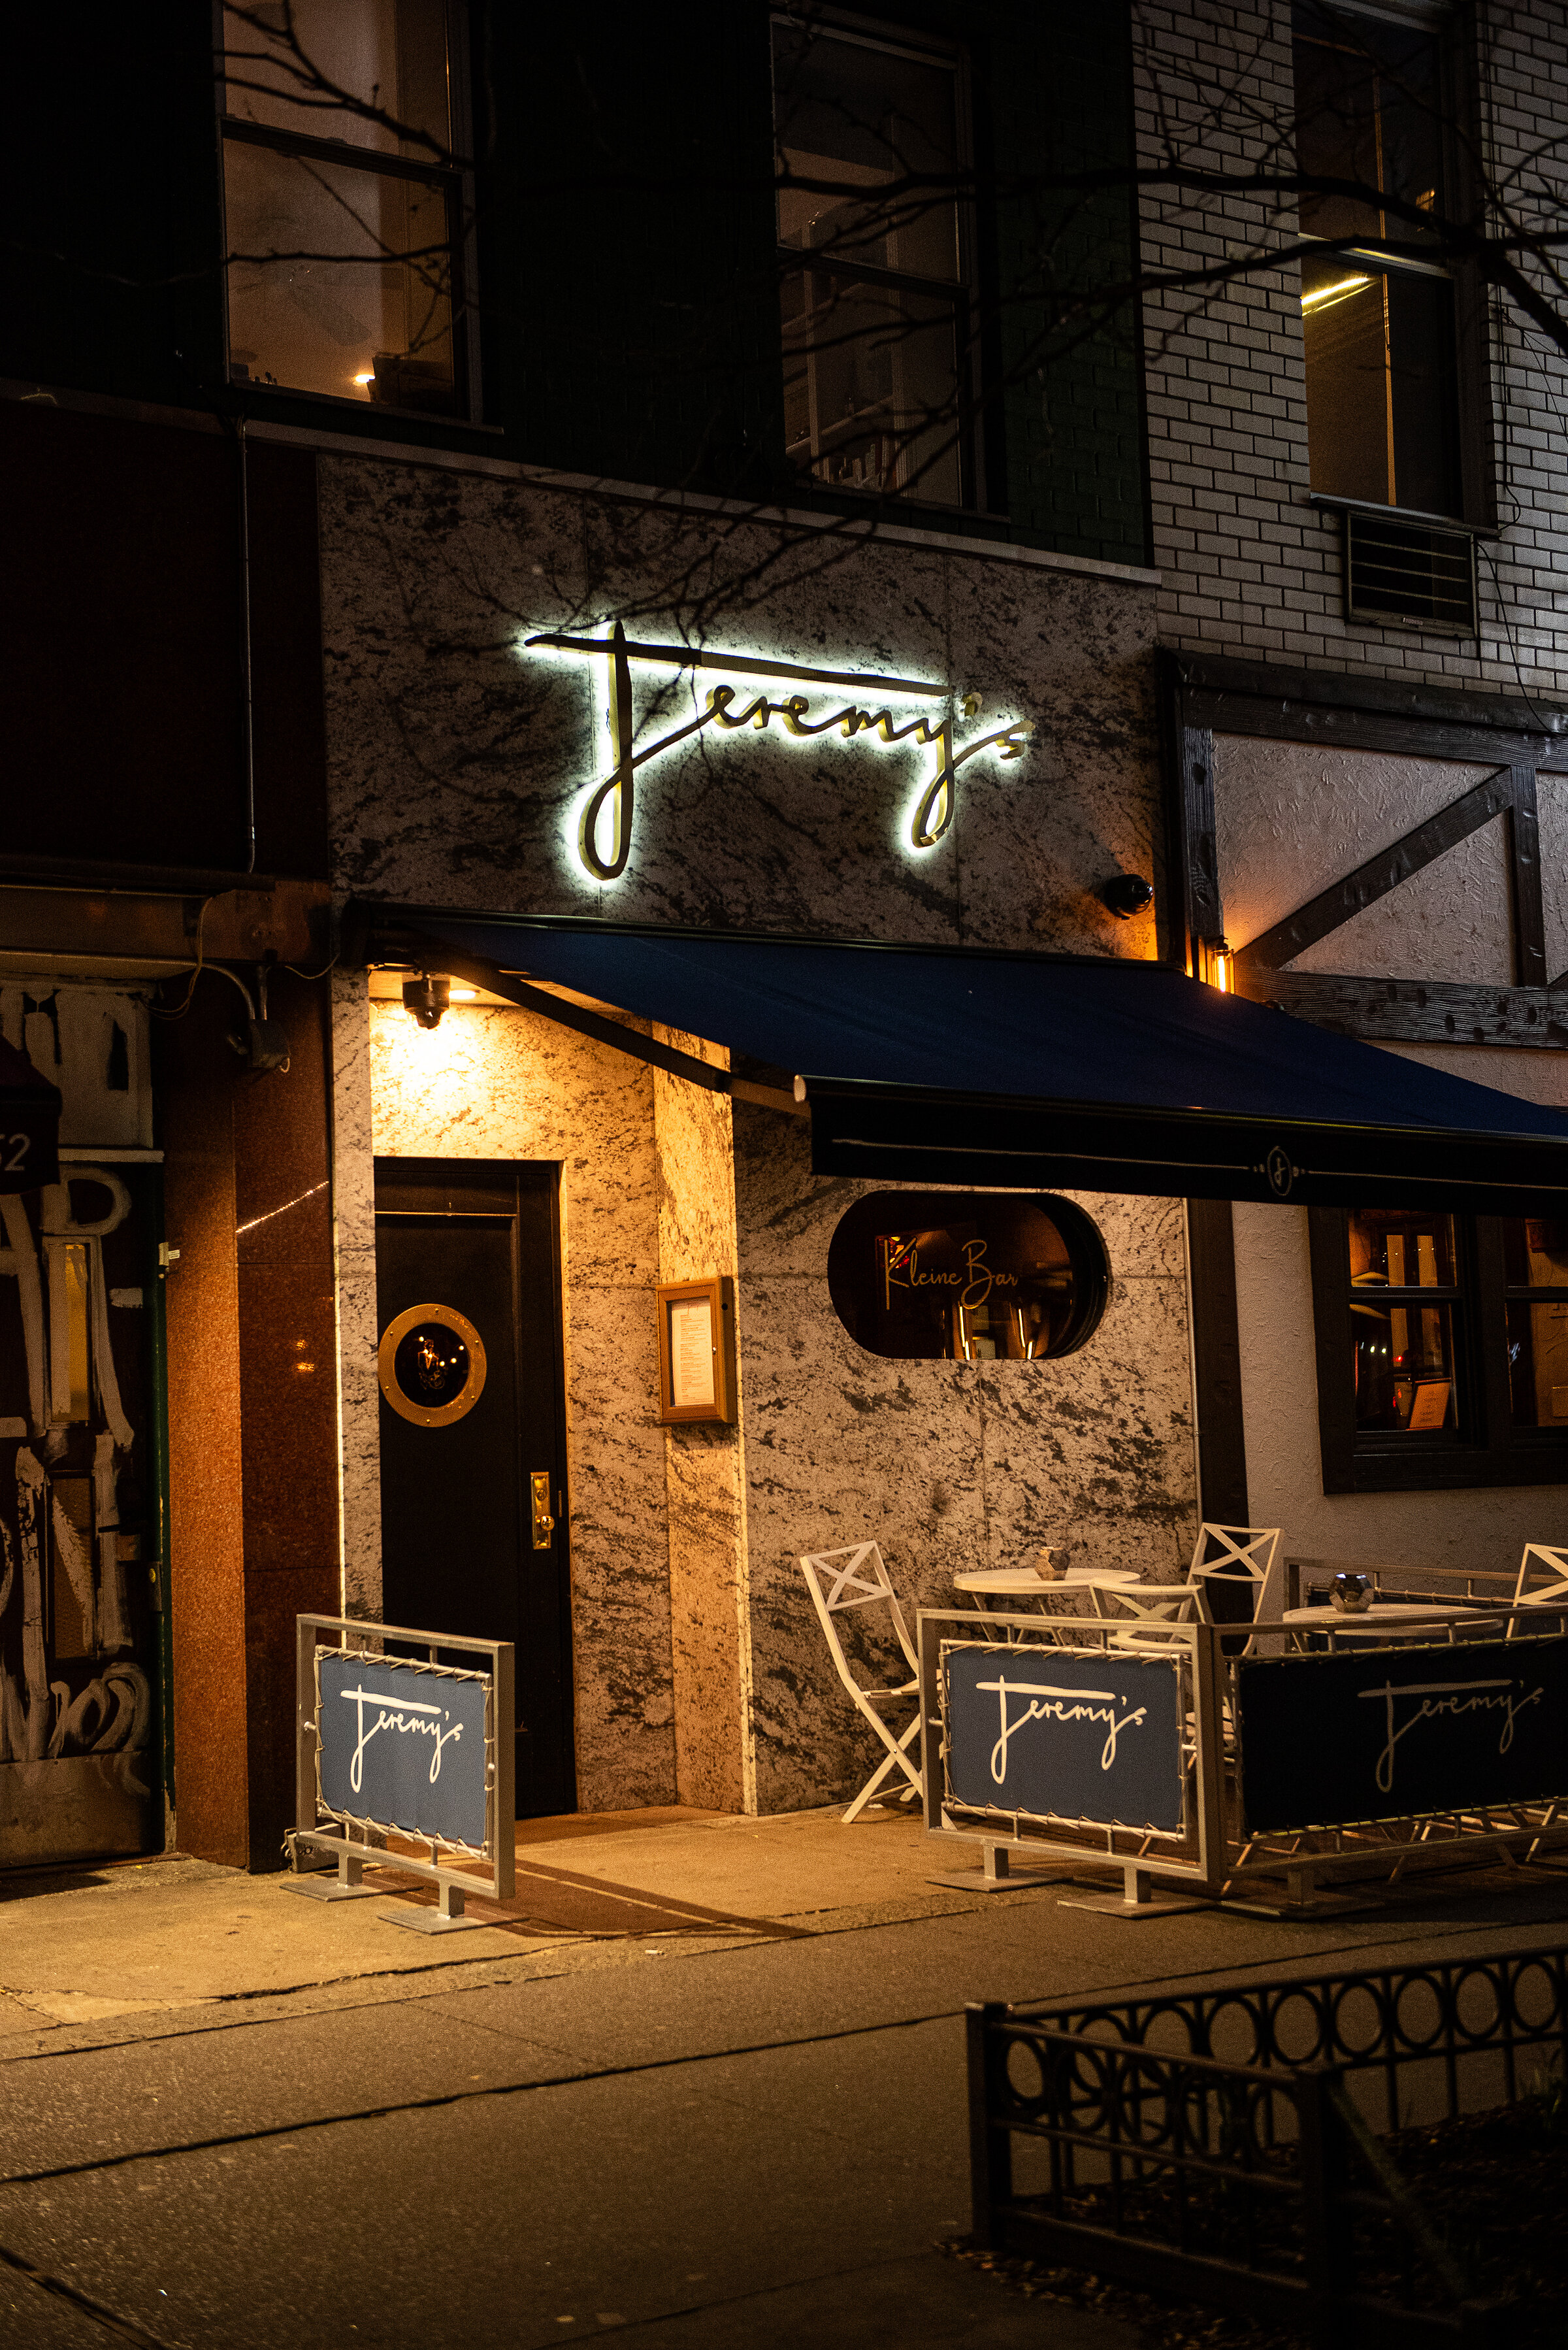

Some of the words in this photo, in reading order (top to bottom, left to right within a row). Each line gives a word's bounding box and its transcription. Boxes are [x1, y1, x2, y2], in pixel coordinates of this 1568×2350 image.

[524, 620, 1036, 881] Jeremy's
[883, 1237, 963, 1311] Kleine
[960, 1239, 1019, 1310] Bar
[340, 1684, 464, 1793] Jeremy's
[975, 1674, 1147, 1785] Jeremy's
[1356, 1679, 1544, 1793] Jeremy's
